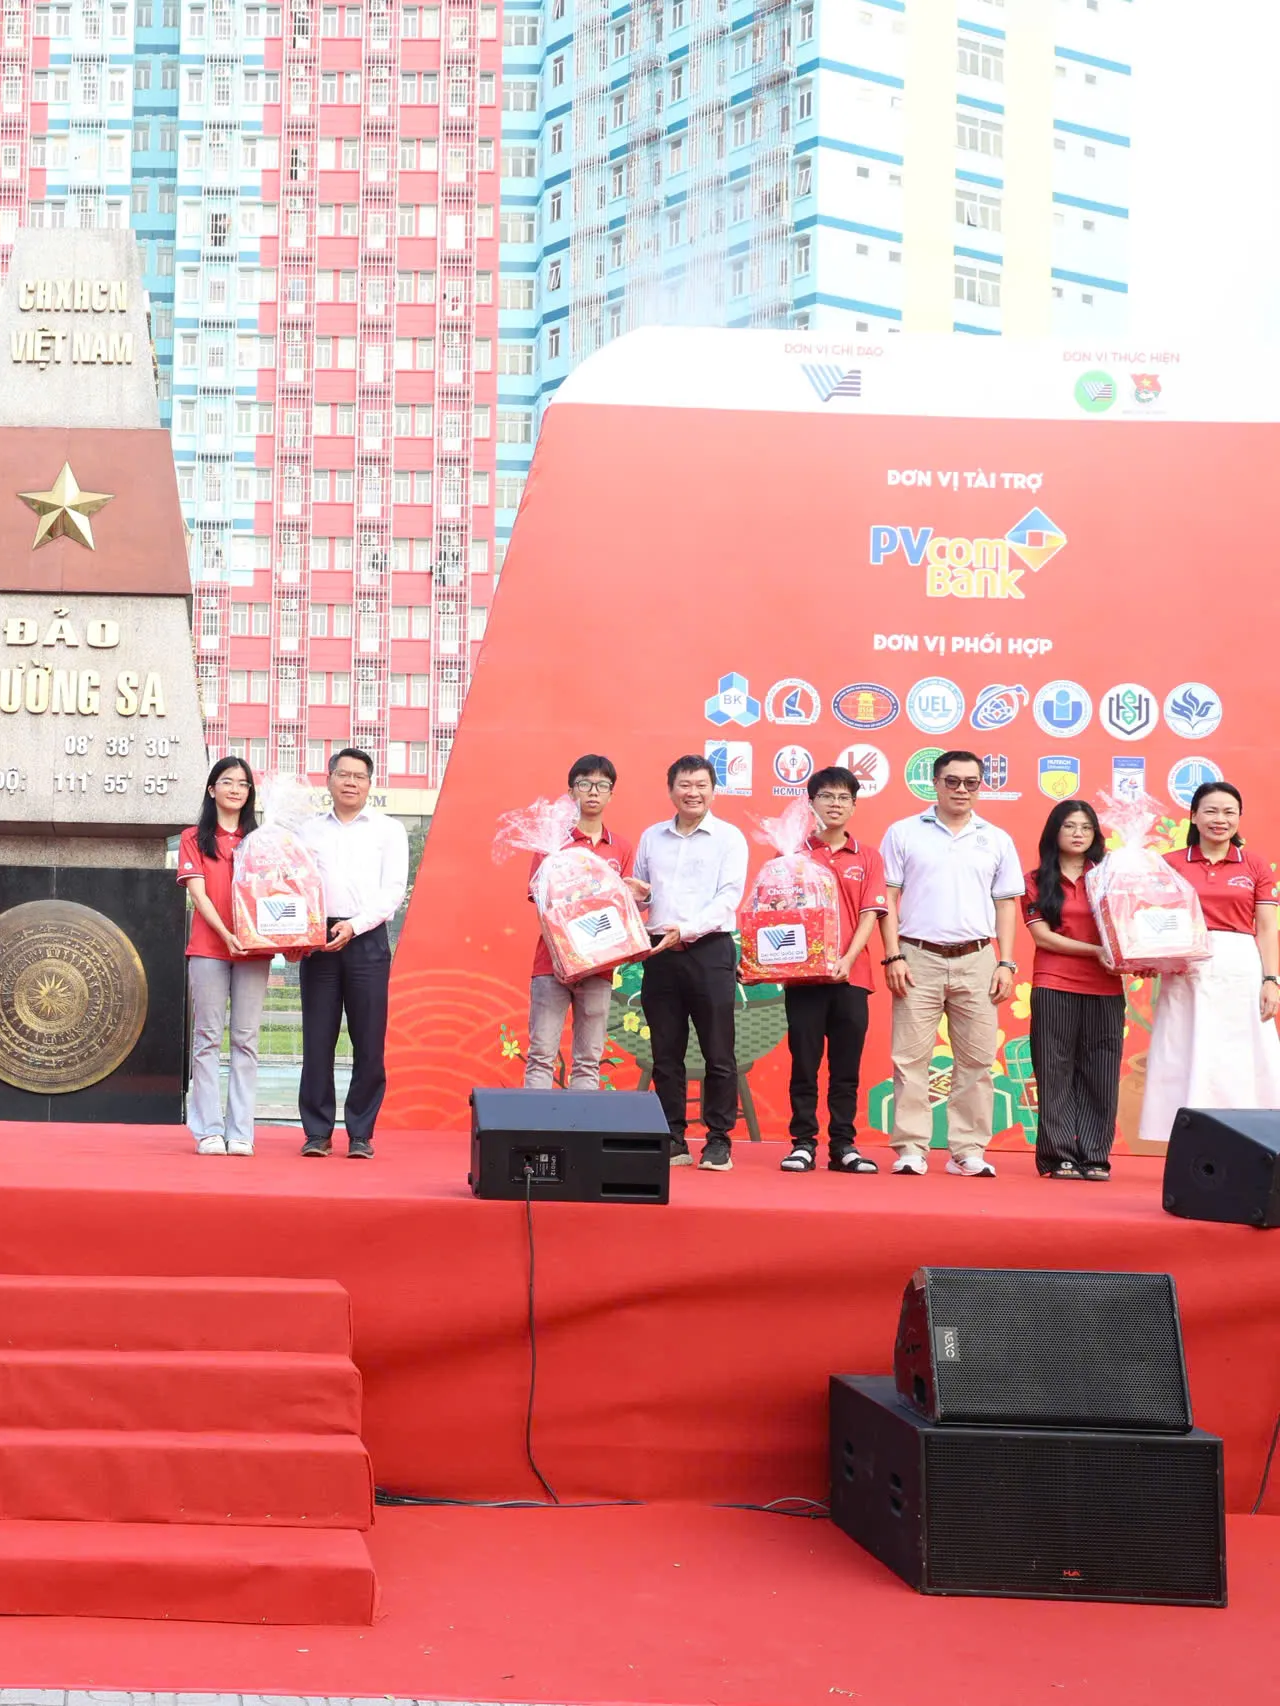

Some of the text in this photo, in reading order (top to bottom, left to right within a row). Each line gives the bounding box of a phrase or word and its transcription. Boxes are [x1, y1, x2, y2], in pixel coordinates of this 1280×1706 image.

[19, 279, 127, 312] CHXHCN
[10, 328, 135, 371] VIỆT NAM
[887, 467, 1044, 494] ĐƠN VỊ TÀI TRỢ
[3, 607, 120, 648] ĐẢO
[873, 632, 1053, 658] ĐƠN VỊ PHỐI HỢP
[116, 670, 166, 717] SA
[723, 694, 742, 705] BK
[918, 695, 952, 712] UEL
[944, 1331, 956, 1358] NEXO
